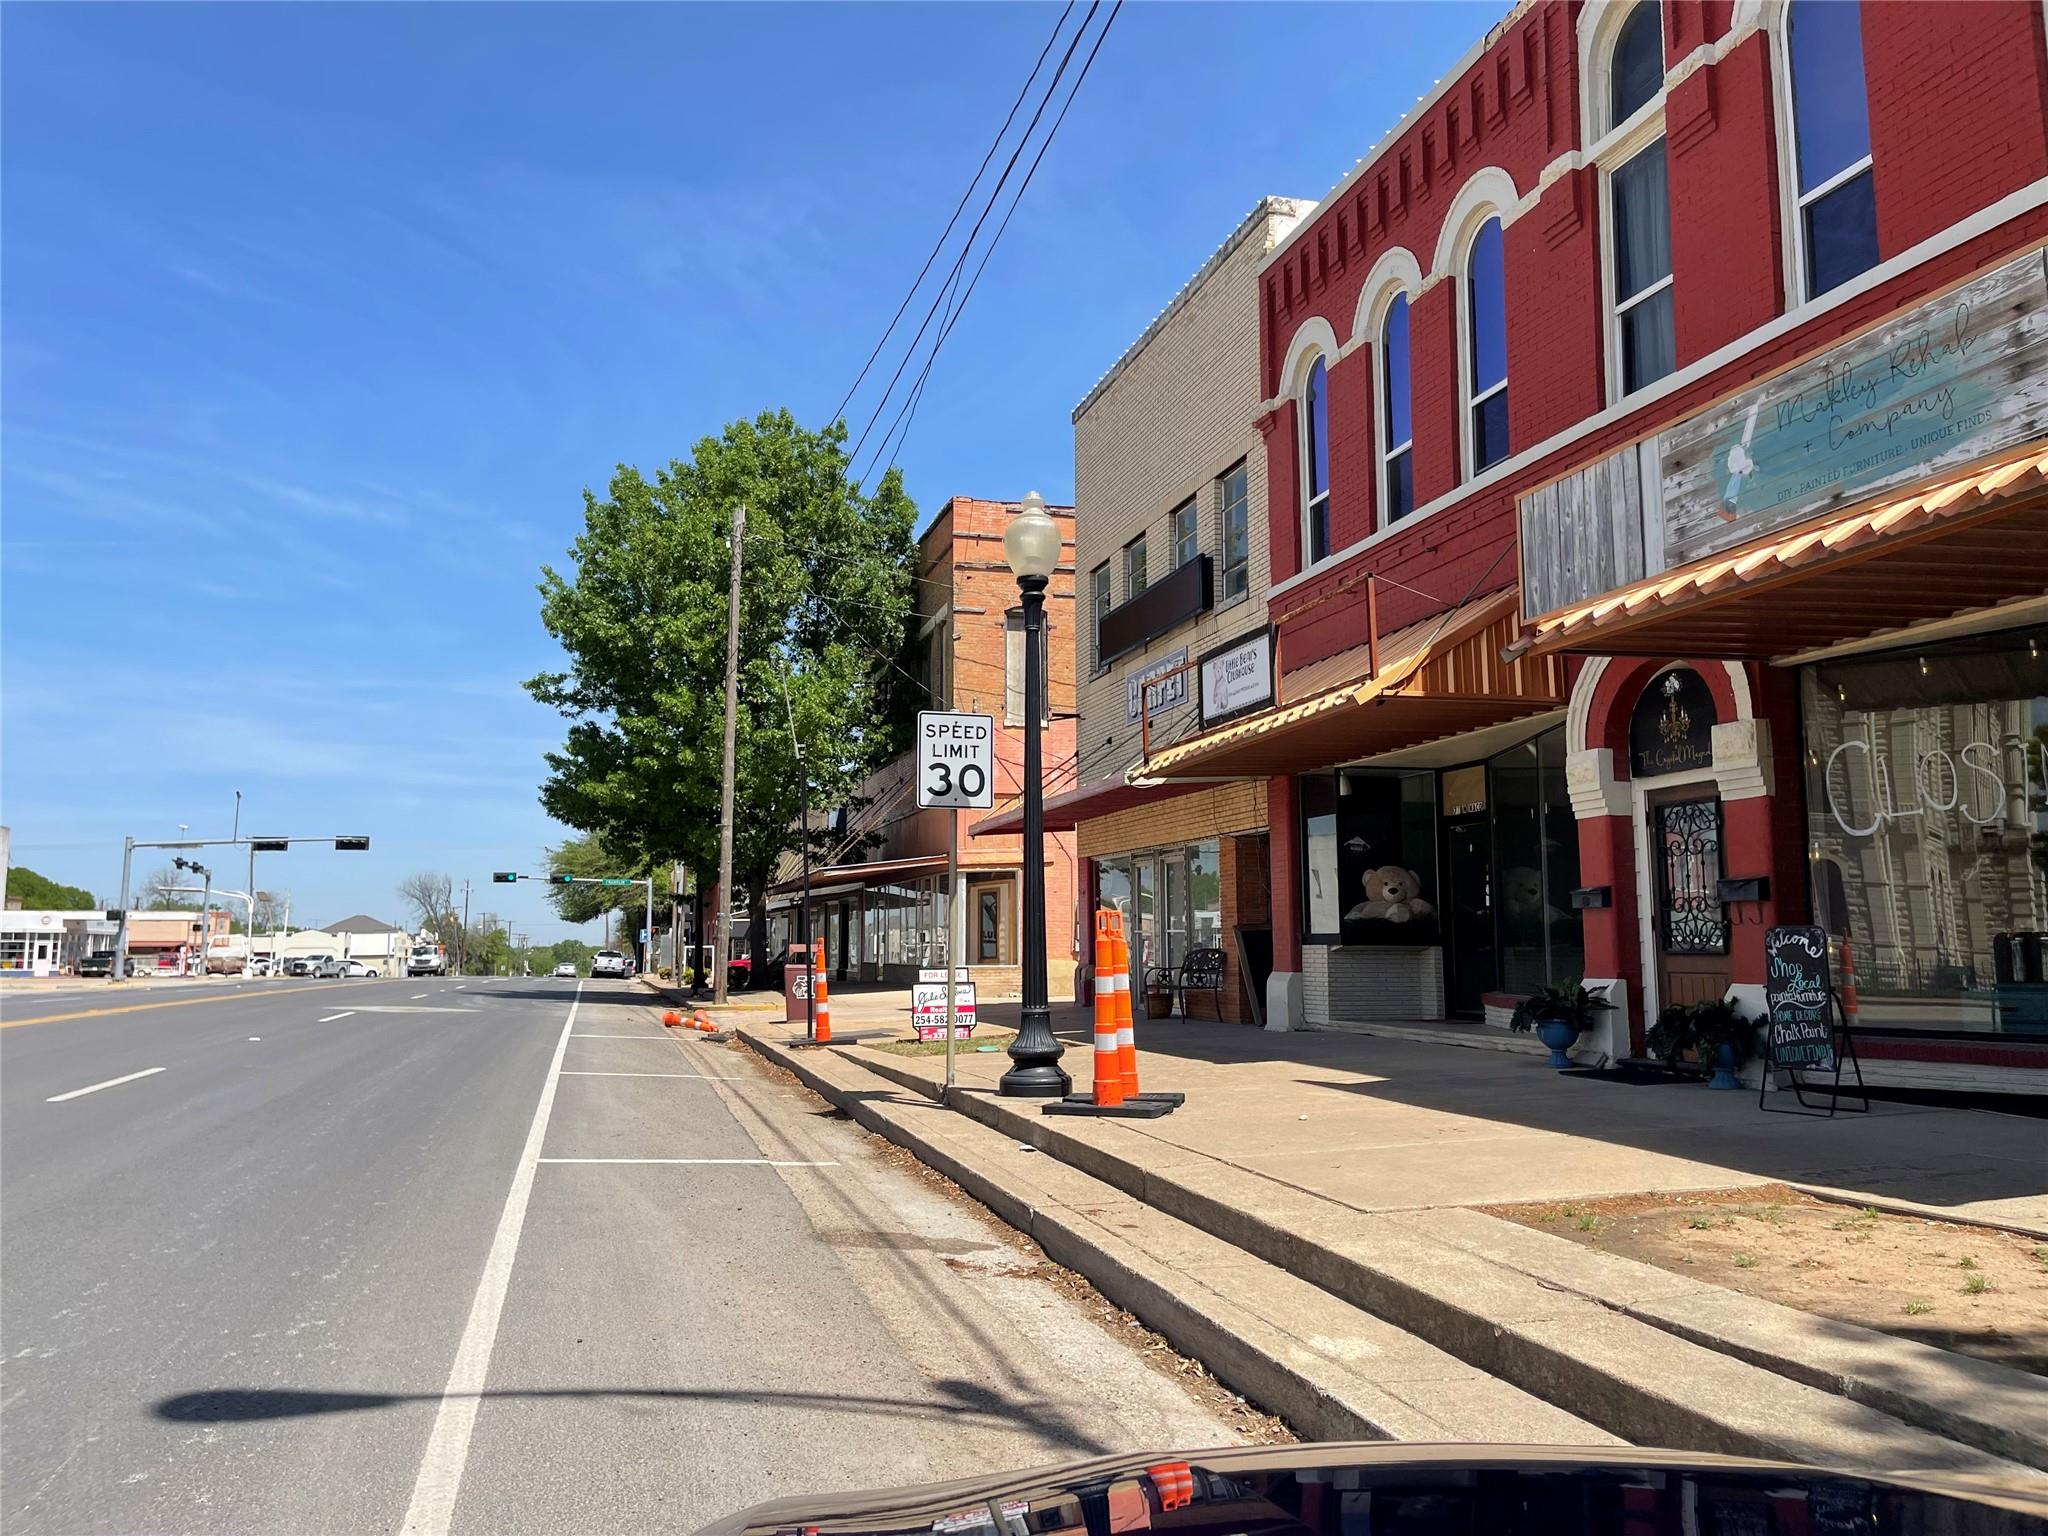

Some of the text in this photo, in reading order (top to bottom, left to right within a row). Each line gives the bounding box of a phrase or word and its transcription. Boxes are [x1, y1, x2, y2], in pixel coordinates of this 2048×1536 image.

[1776, 303, 1979, 431] Makley Rehab
[1828, 386, 1957, 450] Company
[1777, 409, 1993, 502] DIY PAINTED FURNITURE UNIQUE FINDS
[926, 723, 987, 740] SPEED
[932, 743, 980, 759] LIMIT
[926, 762, 986, 798] 30
[1826, 740, 2048, 837] CLOSI
[1767, 928, 1824, 958] Welcome
[924, 971, 938, 979] FOR
[1770, 957, 1803, 979] Shop
[1787, 973, 1822, 993] Local
[1774, 1022, 1828, 1045] Chalk Paint
